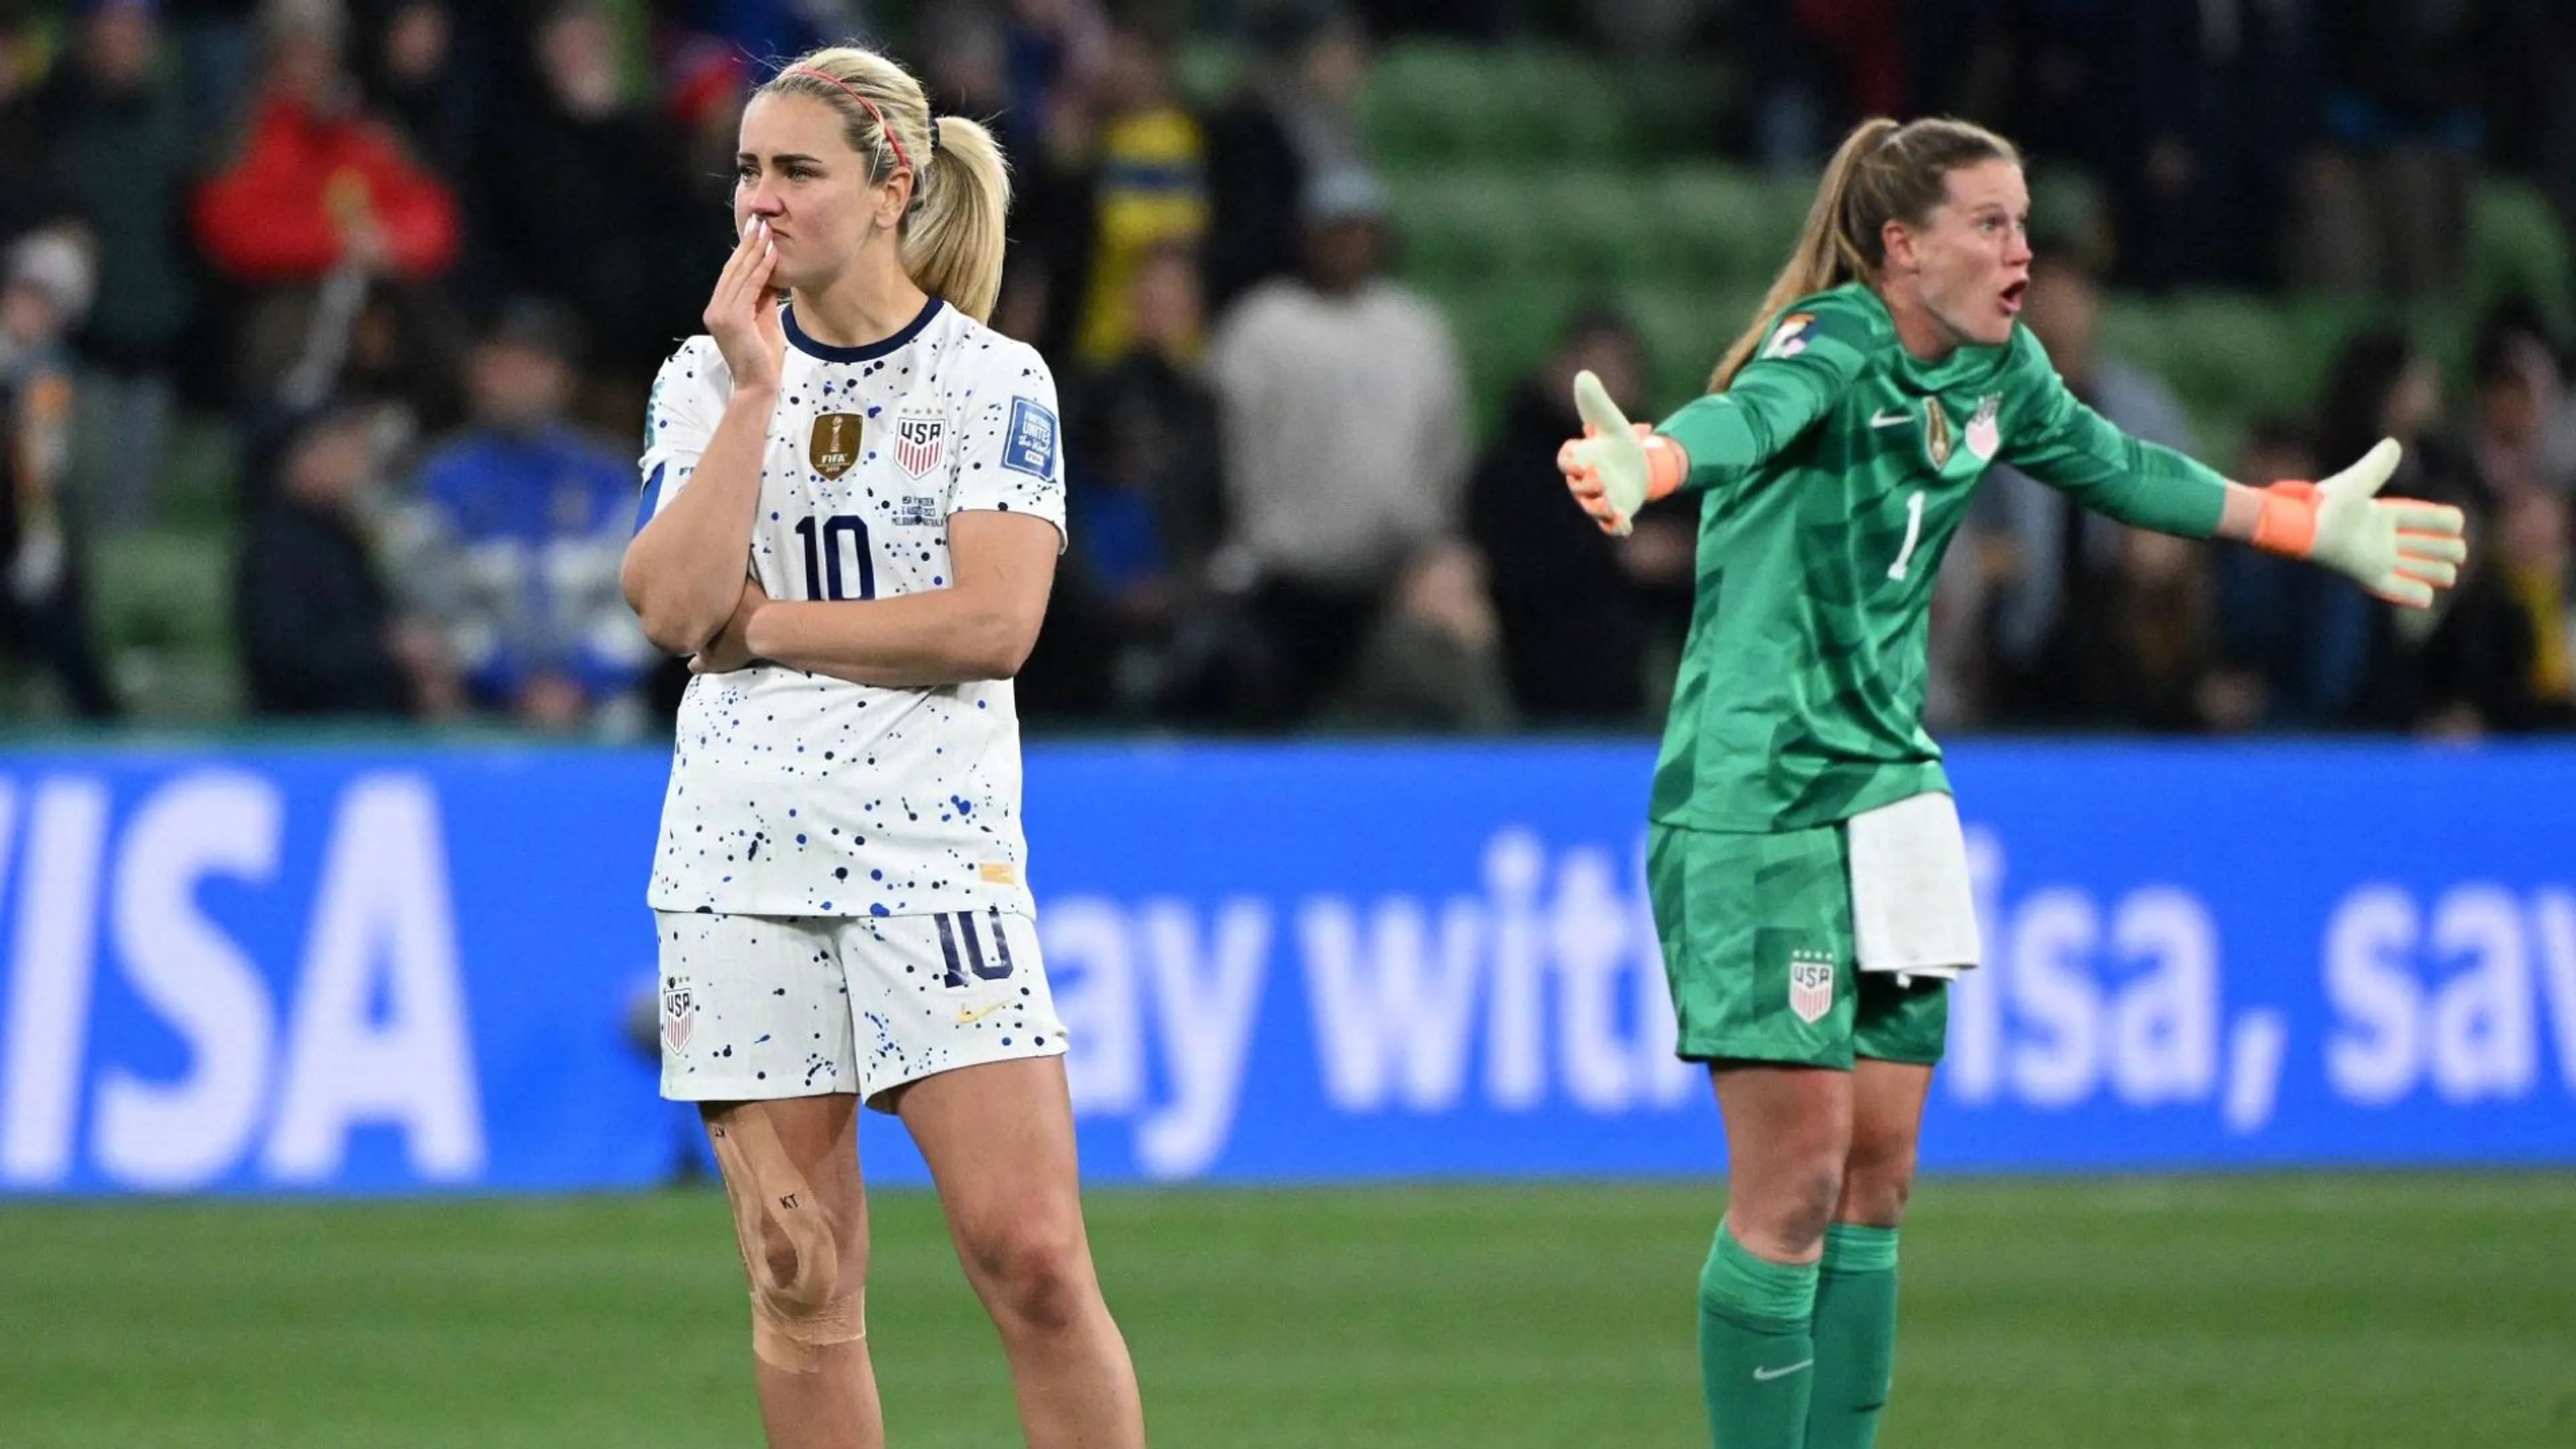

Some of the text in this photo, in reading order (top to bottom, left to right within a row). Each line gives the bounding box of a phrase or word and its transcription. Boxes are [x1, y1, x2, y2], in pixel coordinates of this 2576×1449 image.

[822, 453, 845, 464] FIFA
[901, 422, 941, 445] USA
[796, 515, 875, 601] 10
[1887, 490, 1925, 582] 1
[934, 910, 1014, 988] 10
[0, 771, 486, 1184] ISA
[1038, 896, 1271, 1177] ay
[1947, 825, 2286, 1132] isa,
[1794, 967, 1830, 988] USA
[667, 993, 690, 1018] USA
[779, 1193, 798, 1210] KT
